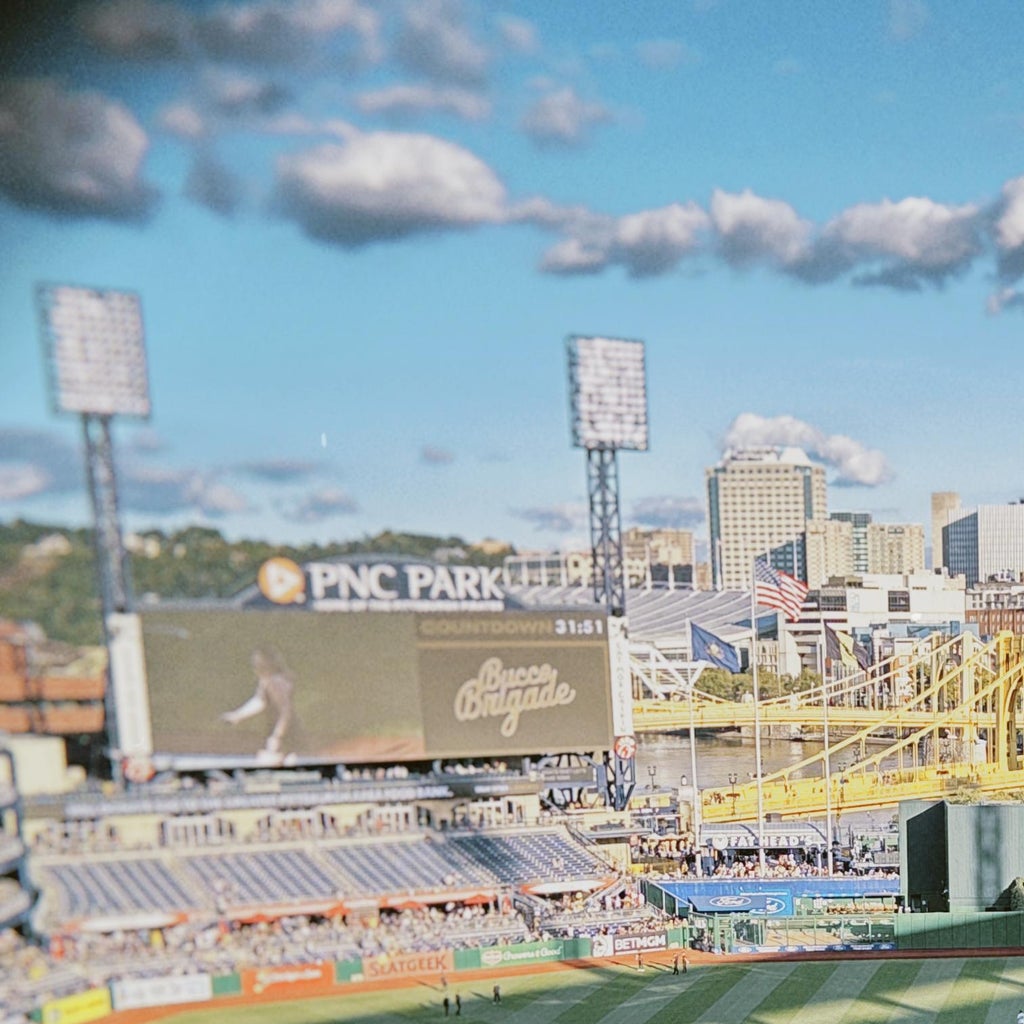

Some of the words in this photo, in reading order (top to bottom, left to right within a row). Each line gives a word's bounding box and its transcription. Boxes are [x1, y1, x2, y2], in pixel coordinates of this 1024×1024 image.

[305, 563, 399, 600] PNC
[403, 565, 505, 600] PARK
[419, 620, 552, 635] COUNTDOWN
[554, 619, 604, 635] 31:51
[454, 669, 577, 737] Brigade
[730, 836, 755, 847] FAT
[615, 935, 666, 950] BETMGM
